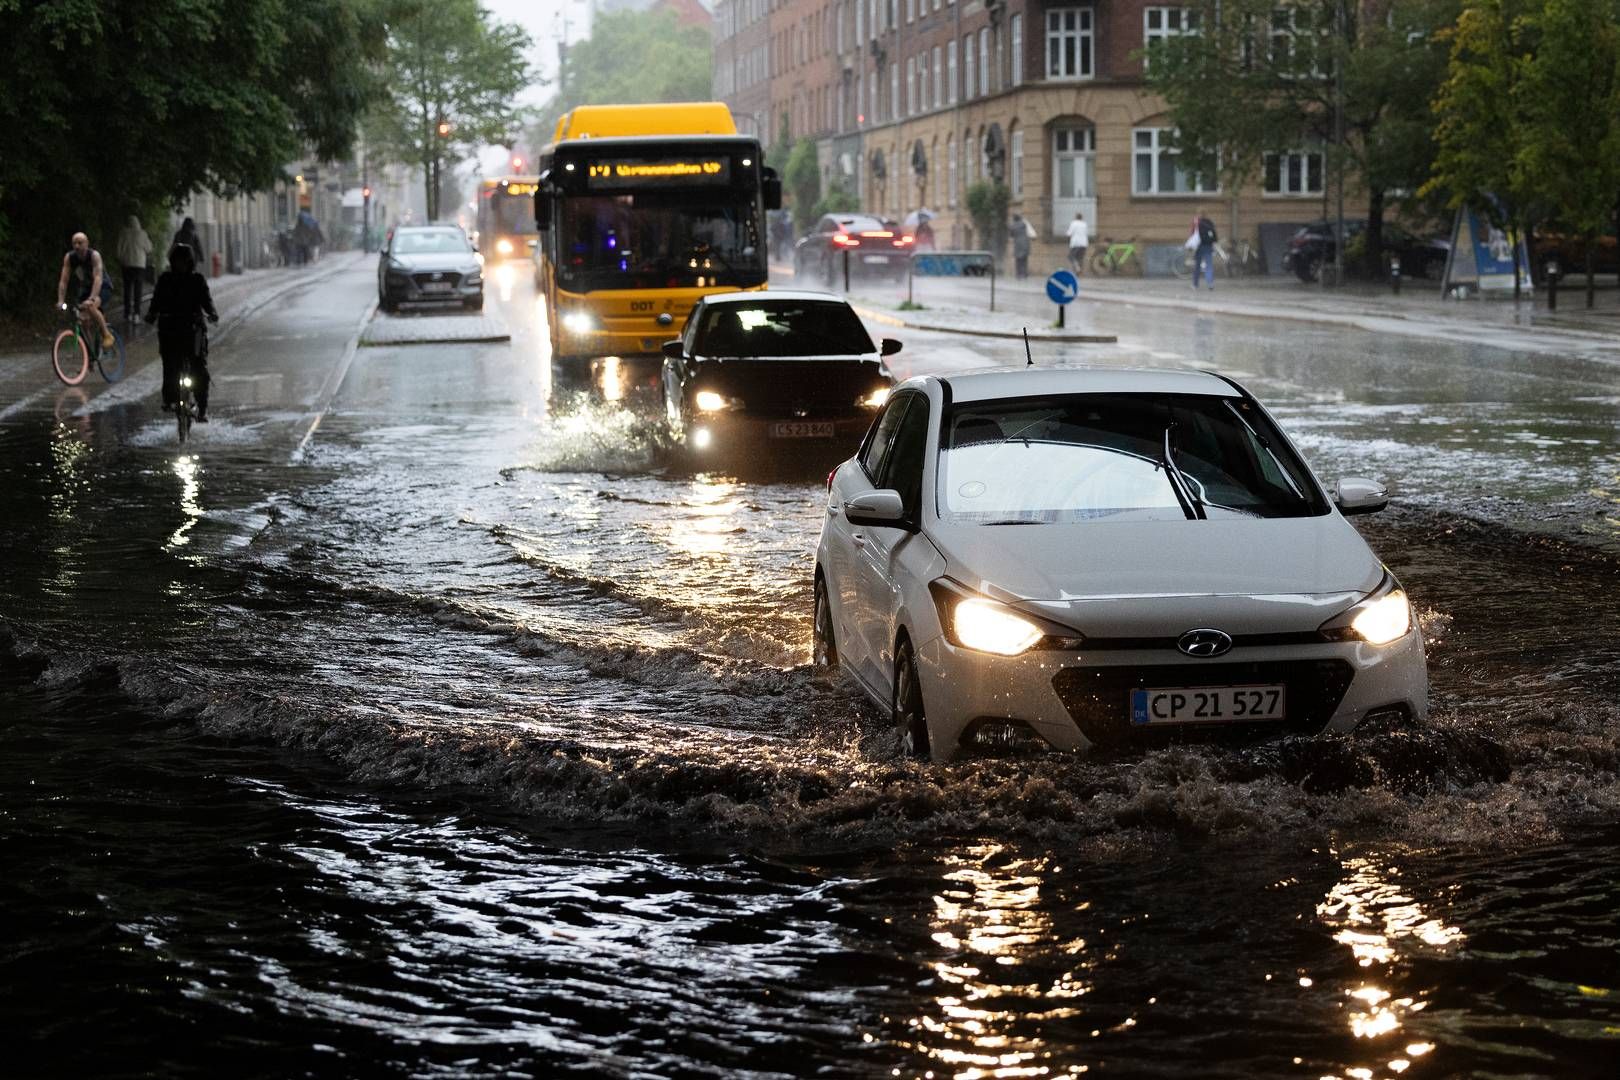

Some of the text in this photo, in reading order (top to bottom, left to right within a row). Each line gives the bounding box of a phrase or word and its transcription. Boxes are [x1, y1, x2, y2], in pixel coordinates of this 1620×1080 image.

[631, 301, 656, 311] DOT
[778, 424, 792, 435] CS
[1151, 690, 1281, 718] CP 21 527
[1135, 710, 1146, 718] DK
